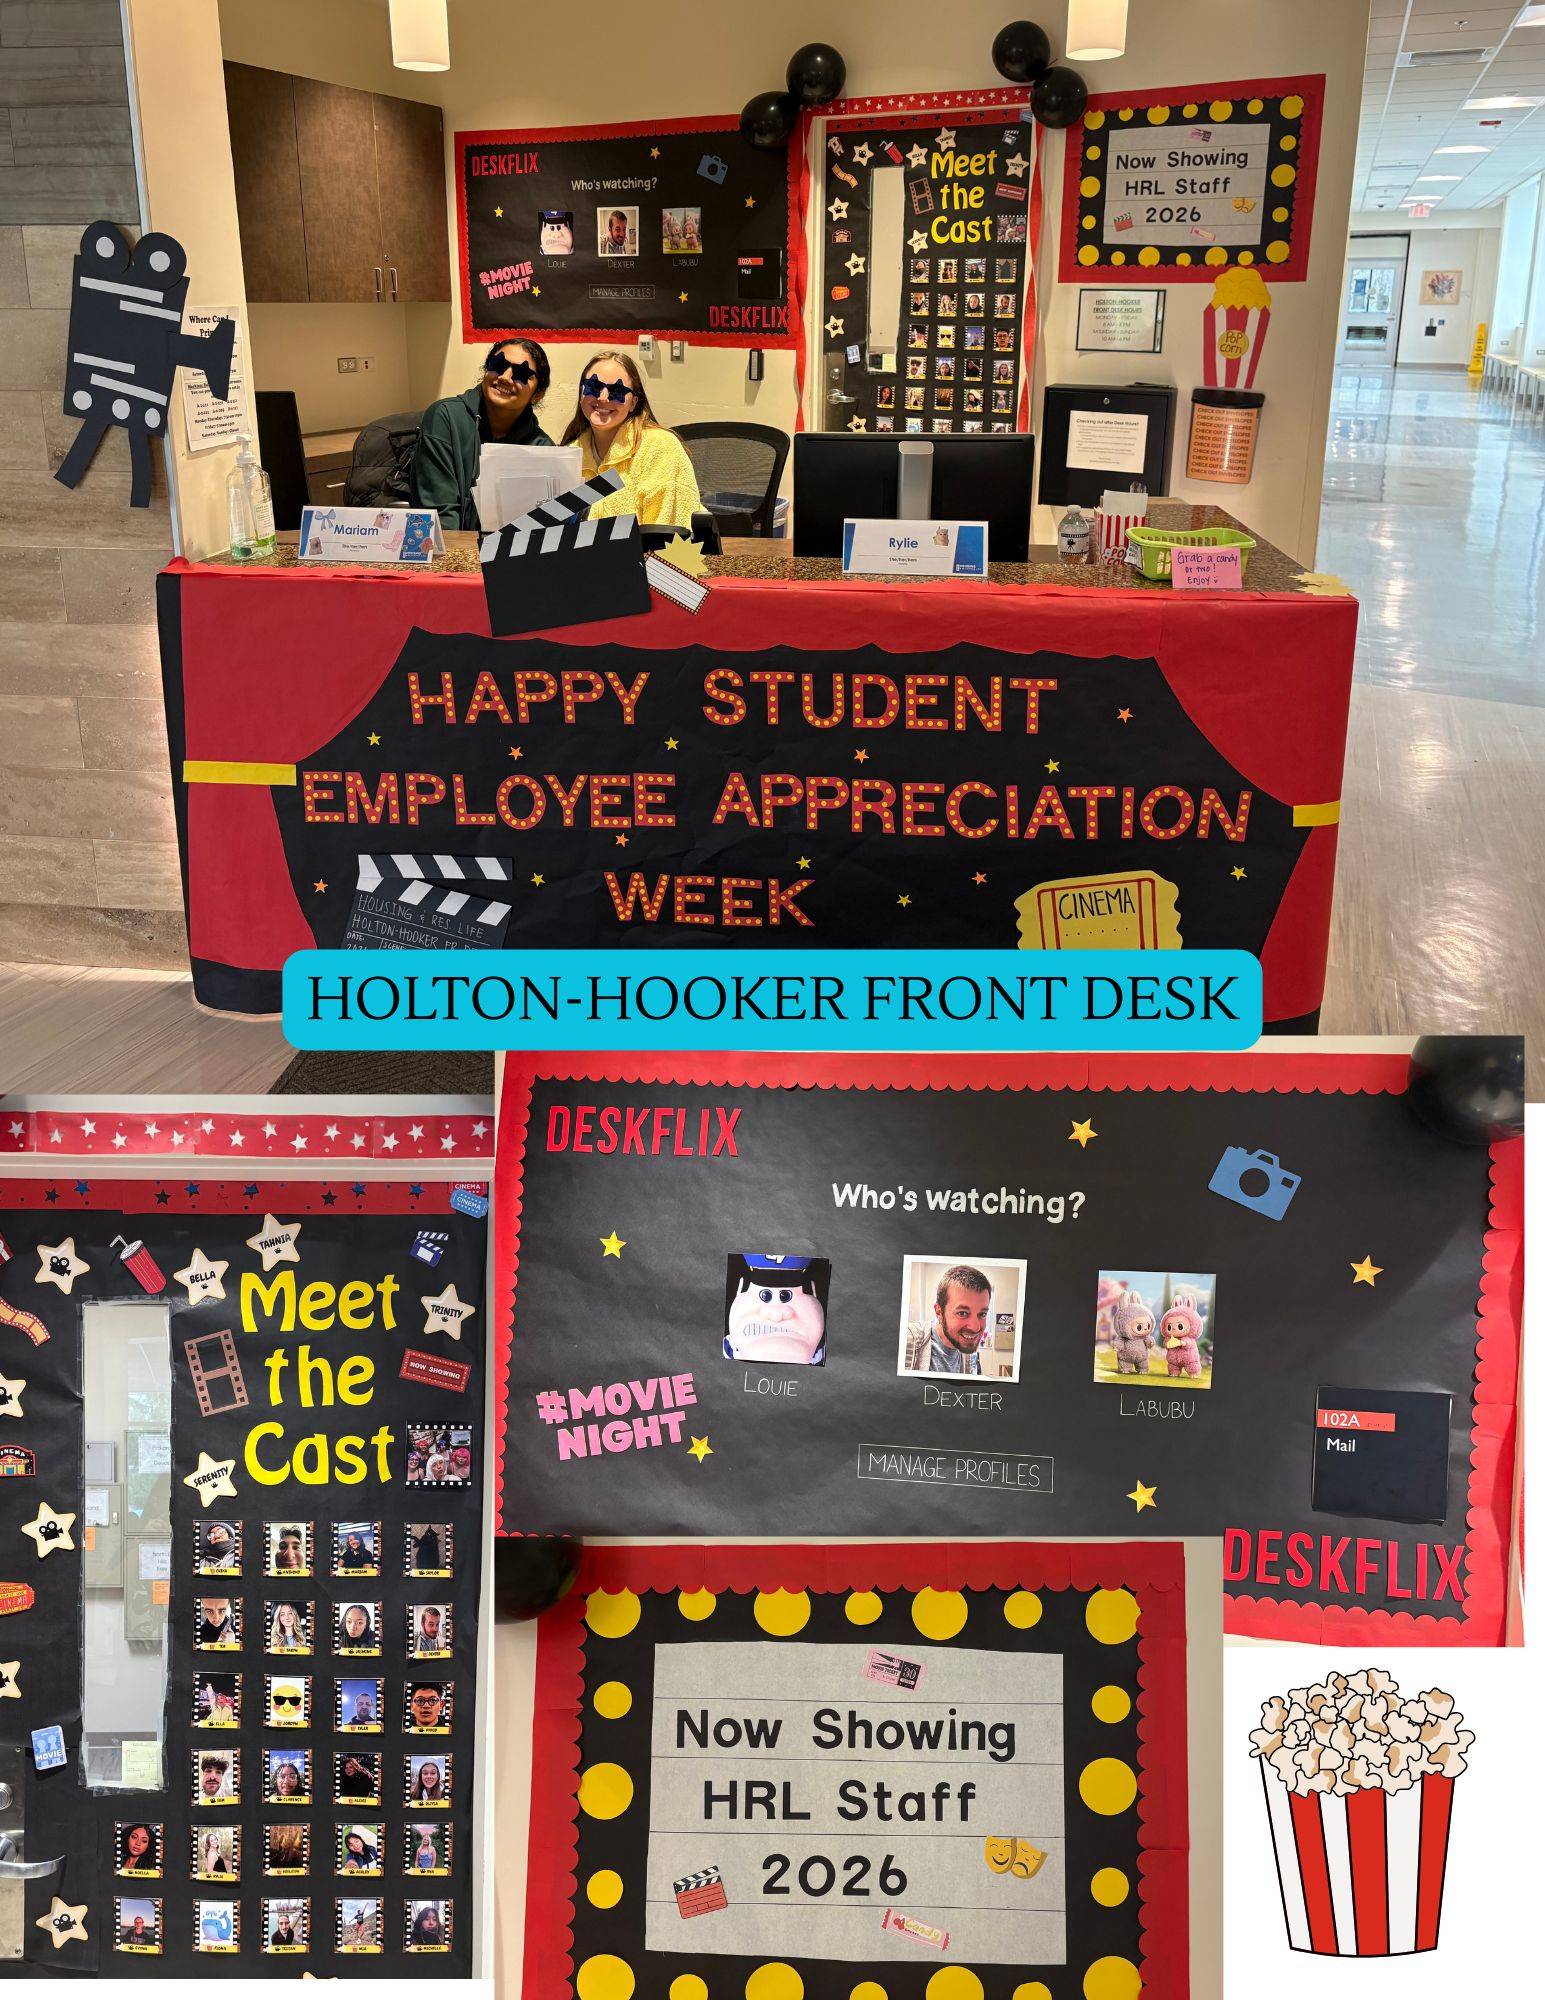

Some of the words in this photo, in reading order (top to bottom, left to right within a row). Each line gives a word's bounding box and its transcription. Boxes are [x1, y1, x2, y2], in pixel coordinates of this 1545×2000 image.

[472, 152, 540, 176] DESKFLIX
[931, 149, 998, 179] Meet
[1115, 154, 1156, 170] Now
[1167, 148, 1248, 168] Showing
[571, 180, 600, 192] Who's
[602, 177, 657, 192] watching?
[940, 182, 985, 210] the
[1125, 180, 1165, 196] HRL
[1175, 177, 1231, 195] Staff
[1146, 206, 1201, 224] 2026
[931, 215, 992, 244] Cast
[479, 260, 534, 286] #MOVIE
[488, 277, 532, 300] NIGHT
[709, 305, 788, 328] DESKFLIX
[333, 524, 379, 536] Mariam
[889, 538, 918, 550] Rylie
[1177, 551, 1202, 564] Grab
[1216, 553, 1238, 566] candy
[408, 670, 651, 725] HAPPY
[702, 668, 1058, 734] STUDENT
[302, 770, 676, 830] EMPLOYEE
[712, 772, 1252, 842] APPRECIATION
[604, 871, 816, 927] WEEK
[1058, 887, 1136, 921] CINEMA
[357, 894, 413, 920] HOUSING
[458, 922, 485, 939] LIFE
[352, 914, 438, 948] HOLTON-HOOKER
[546, 1105, 742, 1158] DESKFLIX
[457, 1196, 481, 1210] CINEMA
[832, 1183, 917, 1211] Who's
[925, 1186, 1086, 1224] watching?
[259, 1233, 292, 1250] TAHNIA
[189, 1270, 216, 1284] BELLA
[240, 1269, 399, 1332] Meet
[431, 1304, 463, 1318] TRINITY
[264, 1345, 375, 1408] the
[410, 1361, 426, 1370] NOW
[429, 1366, 460, 1379] SHOWING
[536, 1373, 697, 1425] #MOVIE
[923, 1386, 1002, 1411] DEXTER
[1119, 1394, 1195, 1420] LABUBU
[1324, 1412, 1360, 1427] 102A
[556, 1410, 688, 1461] NIGHT
[1326, 1437, 1356, 1452] Mail
[244, 1421, 394, 1486] Cast
[193, 1466, 229, 1487] SERENITY
[868, 1452, 947, 1479] MANAGE
[955, 1457, 1041, 1487] PROFILES
[1223, 1528, 1465, 1602] DESKFLIX
[675, 1709, 783, 1749] Now
[812, 1708, 1016, 1762] Showing
[703, 1780, 811, 1820] HRL
[836, 1779, 976, 1821] Staff
[762, 1853, 908, 1897] 2026
